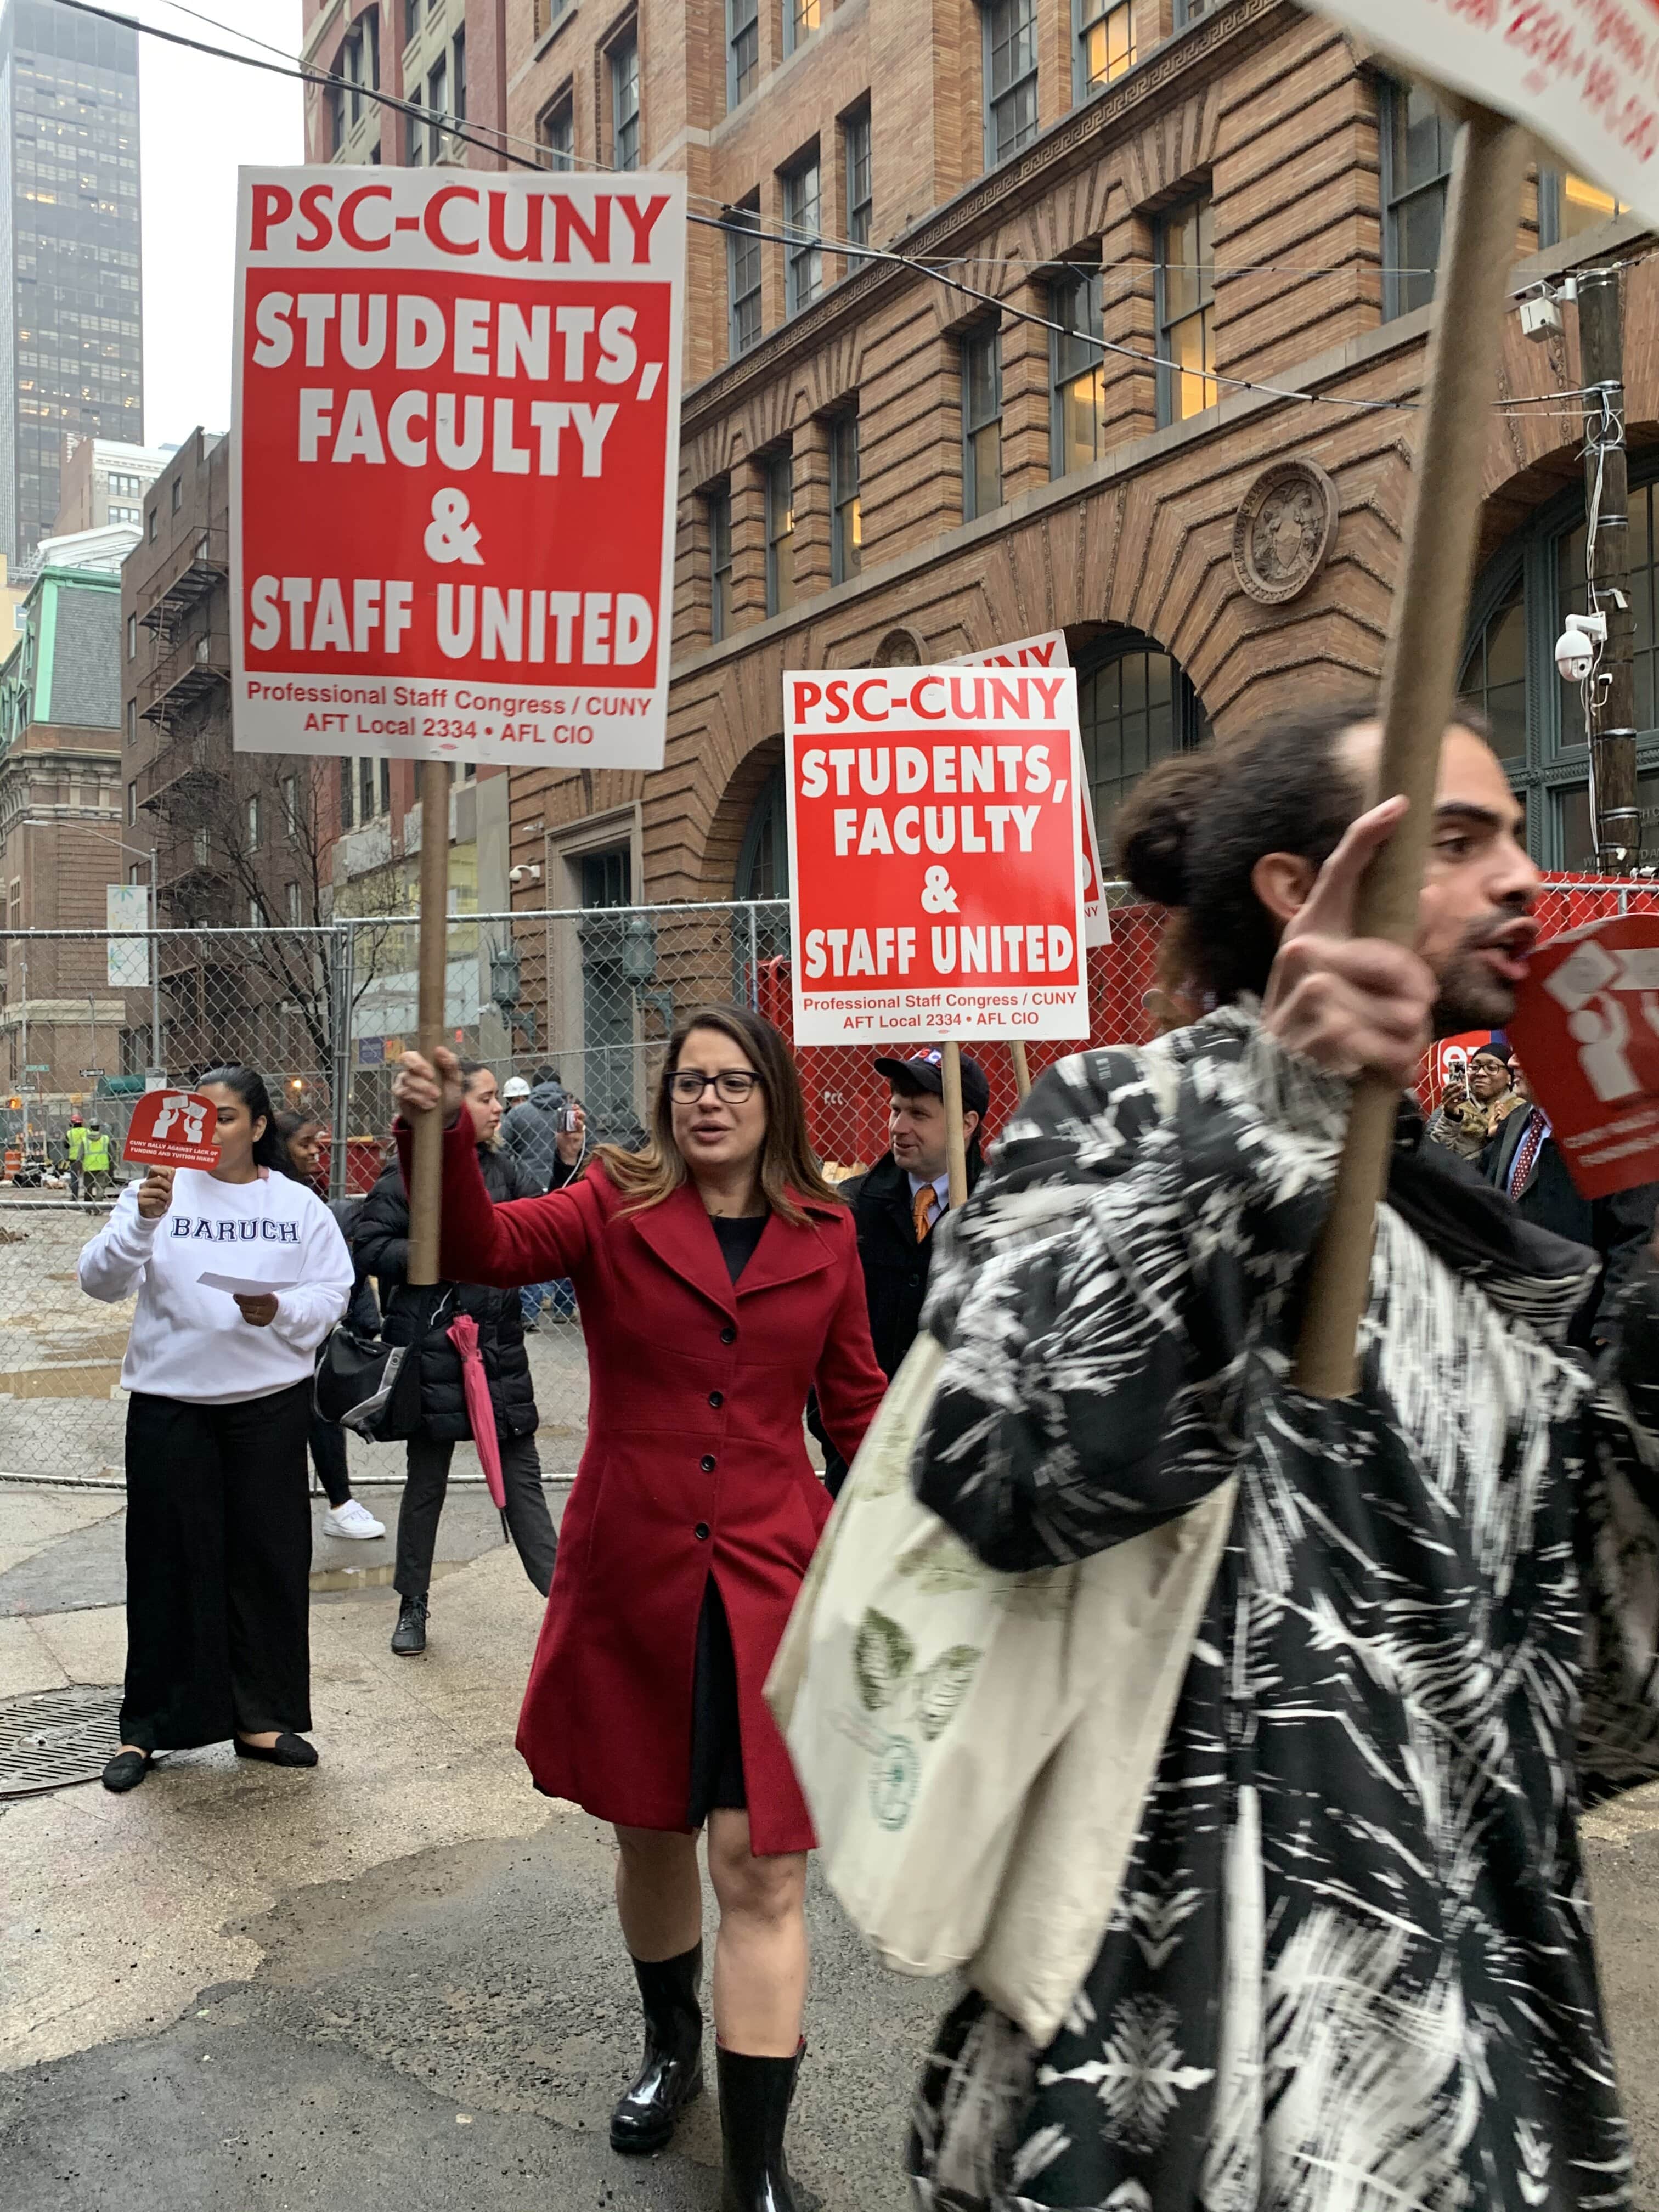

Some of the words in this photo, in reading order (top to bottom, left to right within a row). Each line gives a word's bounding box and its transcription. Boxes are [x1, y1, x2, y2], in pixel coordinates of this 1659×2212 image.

[250, 185, 670, 264] PSC-CUNY
[252, 291, 663, 401] STUDENTS,
[299, 388, 618, 477] FACULTY
[425, 488, 483, 565] &
[250, 575, 413, 653] STAFF
[437, 584, 652, 665] UNITED
[247, 681, 386, 704] Professional
[394, 686, 447, 707] Staff
[455, 690, 565, 718] Congress
[586, 697, 651, 716] CUNY
[794, 677, 1066, 724] PSC-CUNY
[305, 713, 348, 731] AFT
[357, 715, 415, 735] Local
[423, 718, 477, 738] 2334
[501, 723, 545, 742] AFL
[553, 724, 594, 744] CIO
[802, 744, 1068, 803] STUDENTS,
[834, 805, 1041, 855] FACULTY
[922, 866, 960, 913] &
[806, 927, 915, 978] STAFF
[932, 926, 1073, 974] UNITED
[803, 996, 900, 1010] Professional
[906, 995, 941, 1007] Staff
[946, 994, 1018, 1009] Congress
[1032, 992, 1075, 1005] CUNY
[844, 1015, 872, 1028] AFT
[879, 1015, 921, 1028] Local
[927, 1013, 961, 1026] 2334
[977, 1013, 1006, 1024] AFL
[1011, 1012, 1039, 1024] CIO
[171, 1216, 301, 1244] BARUCH
